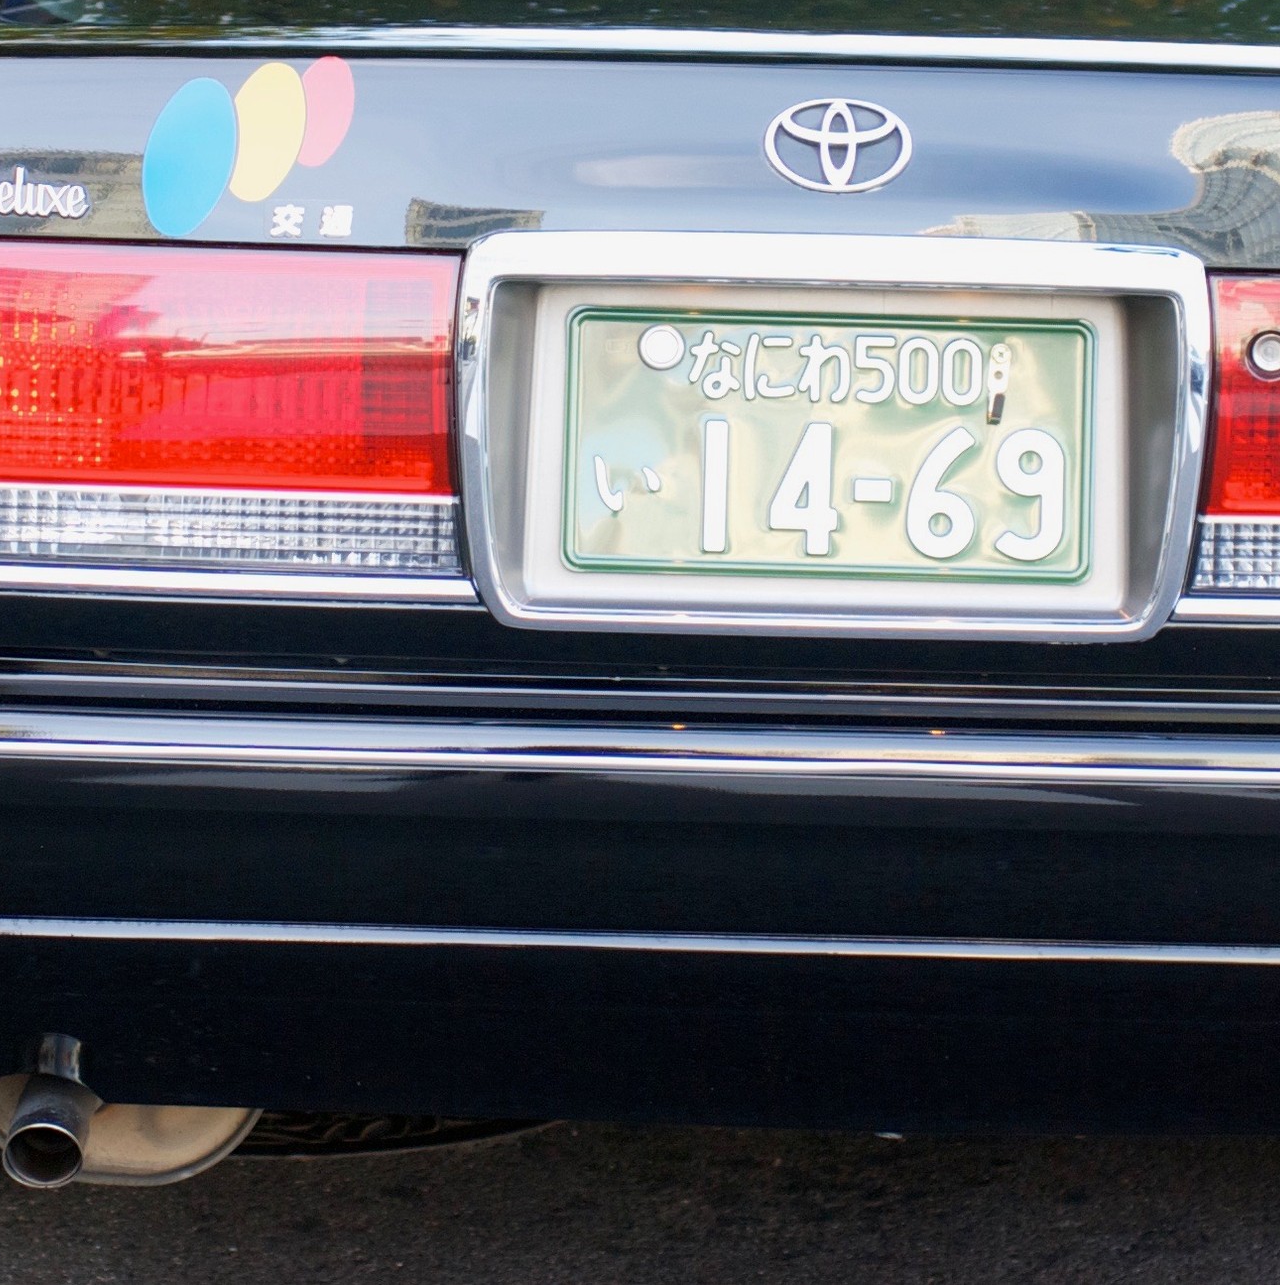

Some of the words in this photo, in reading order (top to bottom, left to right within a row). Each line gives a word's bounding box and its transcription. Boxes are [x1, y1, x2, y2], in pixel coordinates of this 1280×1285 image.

[270, 204, 354, 238] 交通
[687, 329, 985, 407] なにわ500
[592, 453, 663, 512] い
[701, 418, 1066, 562] 14-69
